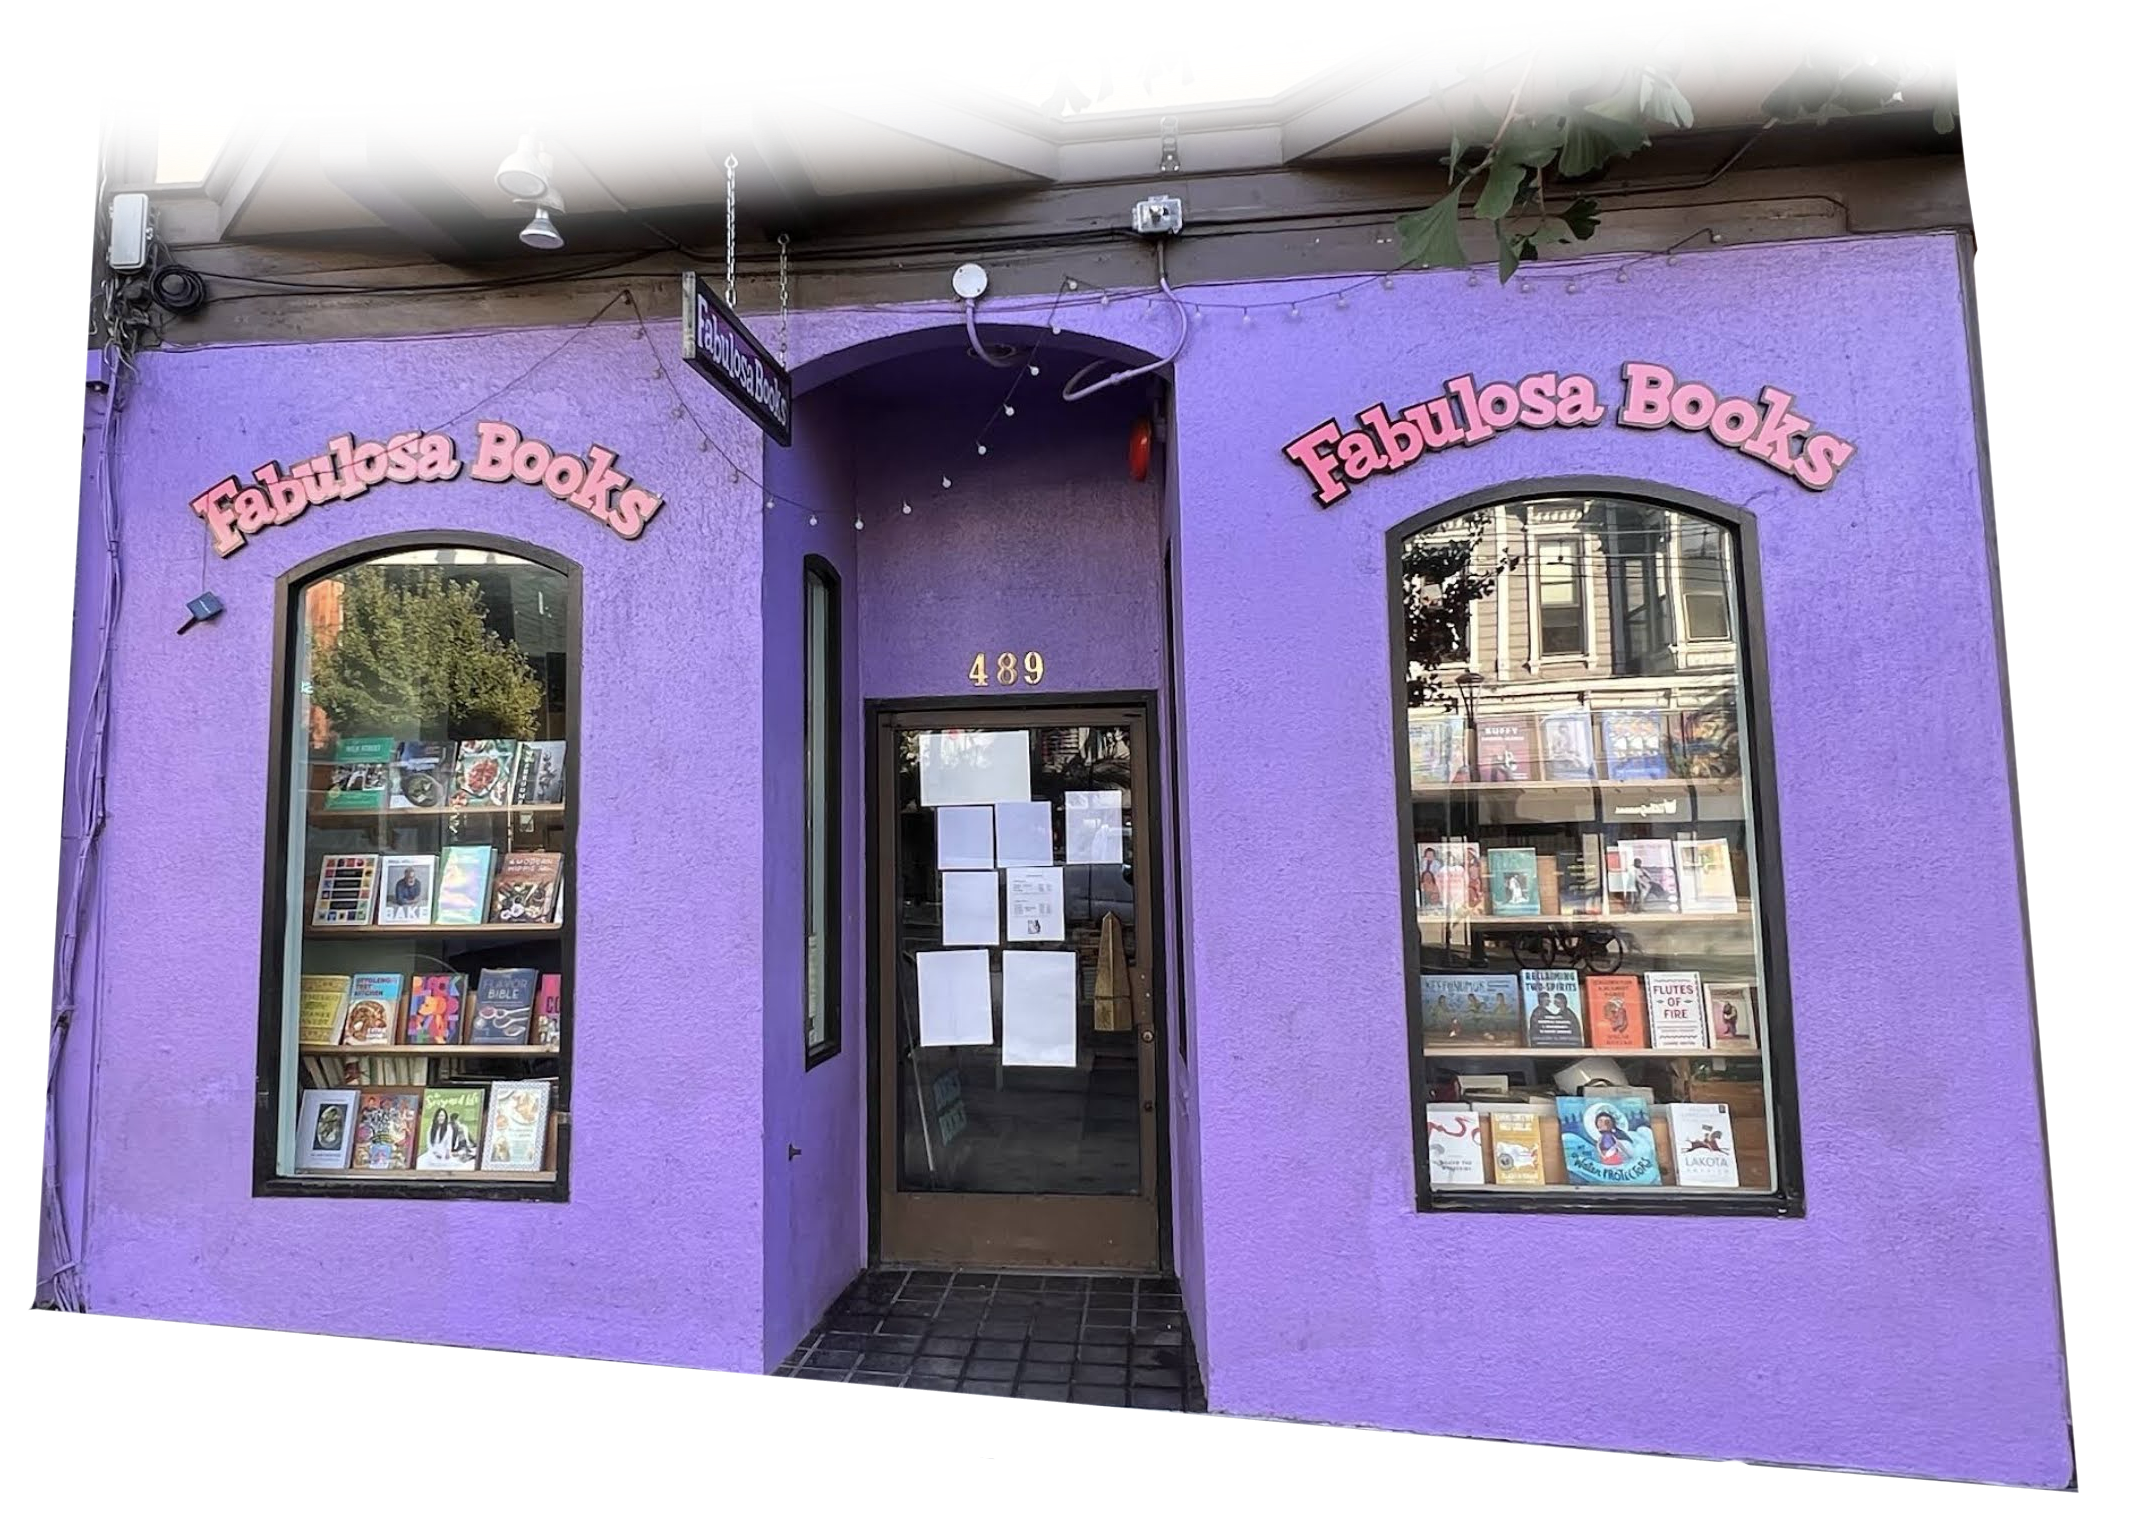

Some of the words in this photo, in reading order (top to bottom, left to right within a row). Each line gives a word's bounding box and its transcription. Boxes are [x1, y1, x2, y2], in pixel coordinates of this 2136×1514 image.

[698, 293, 754, 398] Fabulosa
[754, 358, 788, 426] Books
[1284, 371, 1603, 508] Fabulosa
[1617, 361, 1855, 491] Books
[190, 430, 462, 558] Fabulosa
[472, 420, 664, 540] Books
[968, 651, 1044, 687] 489
[384, 906, 429, 920] BAKE
[1525, 972, 1576, 980] RECLAIMING
[483, 979, 528, 989] FLAVOR
[487, 989, 520, 999] BIBLE
[1653, 985, 1694, 995] FLUTES
[1667, 997, 1681, 1006] OF
[1664, 1009, 1688, 1019] FIRE
[1685, 1157, 1730, 1167] LAKOTA
[1603, 1157, 1653, 1180] PROTECTORS
